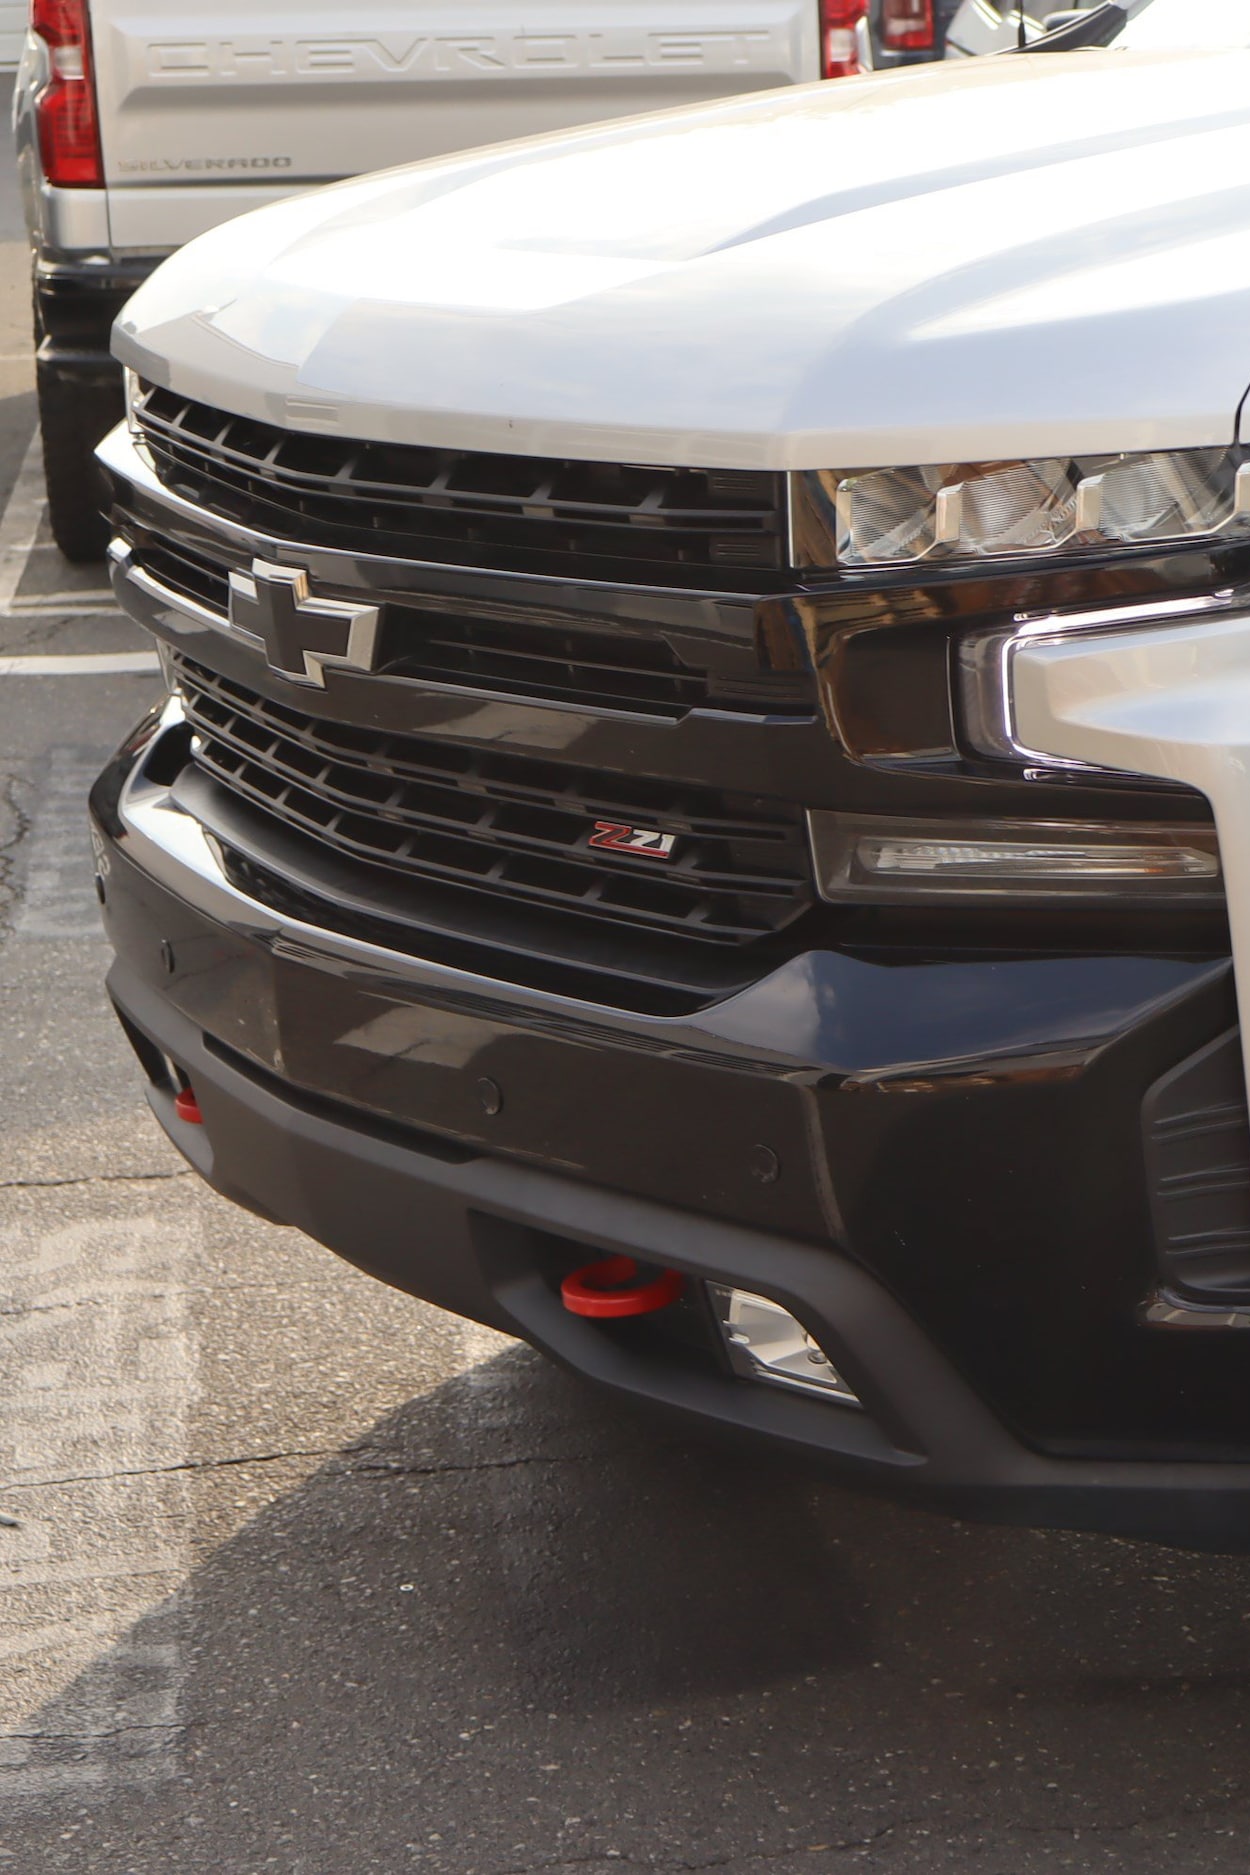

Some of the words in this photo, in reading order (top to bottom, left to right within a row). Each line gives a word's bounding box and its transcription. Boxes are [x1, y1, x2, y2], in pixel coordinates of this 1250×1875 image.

[148, 30, 769, 76] CHEVROLET
[118, 156, 293, 172] SILVERADO
[588, 821, 676, 859] Z71
